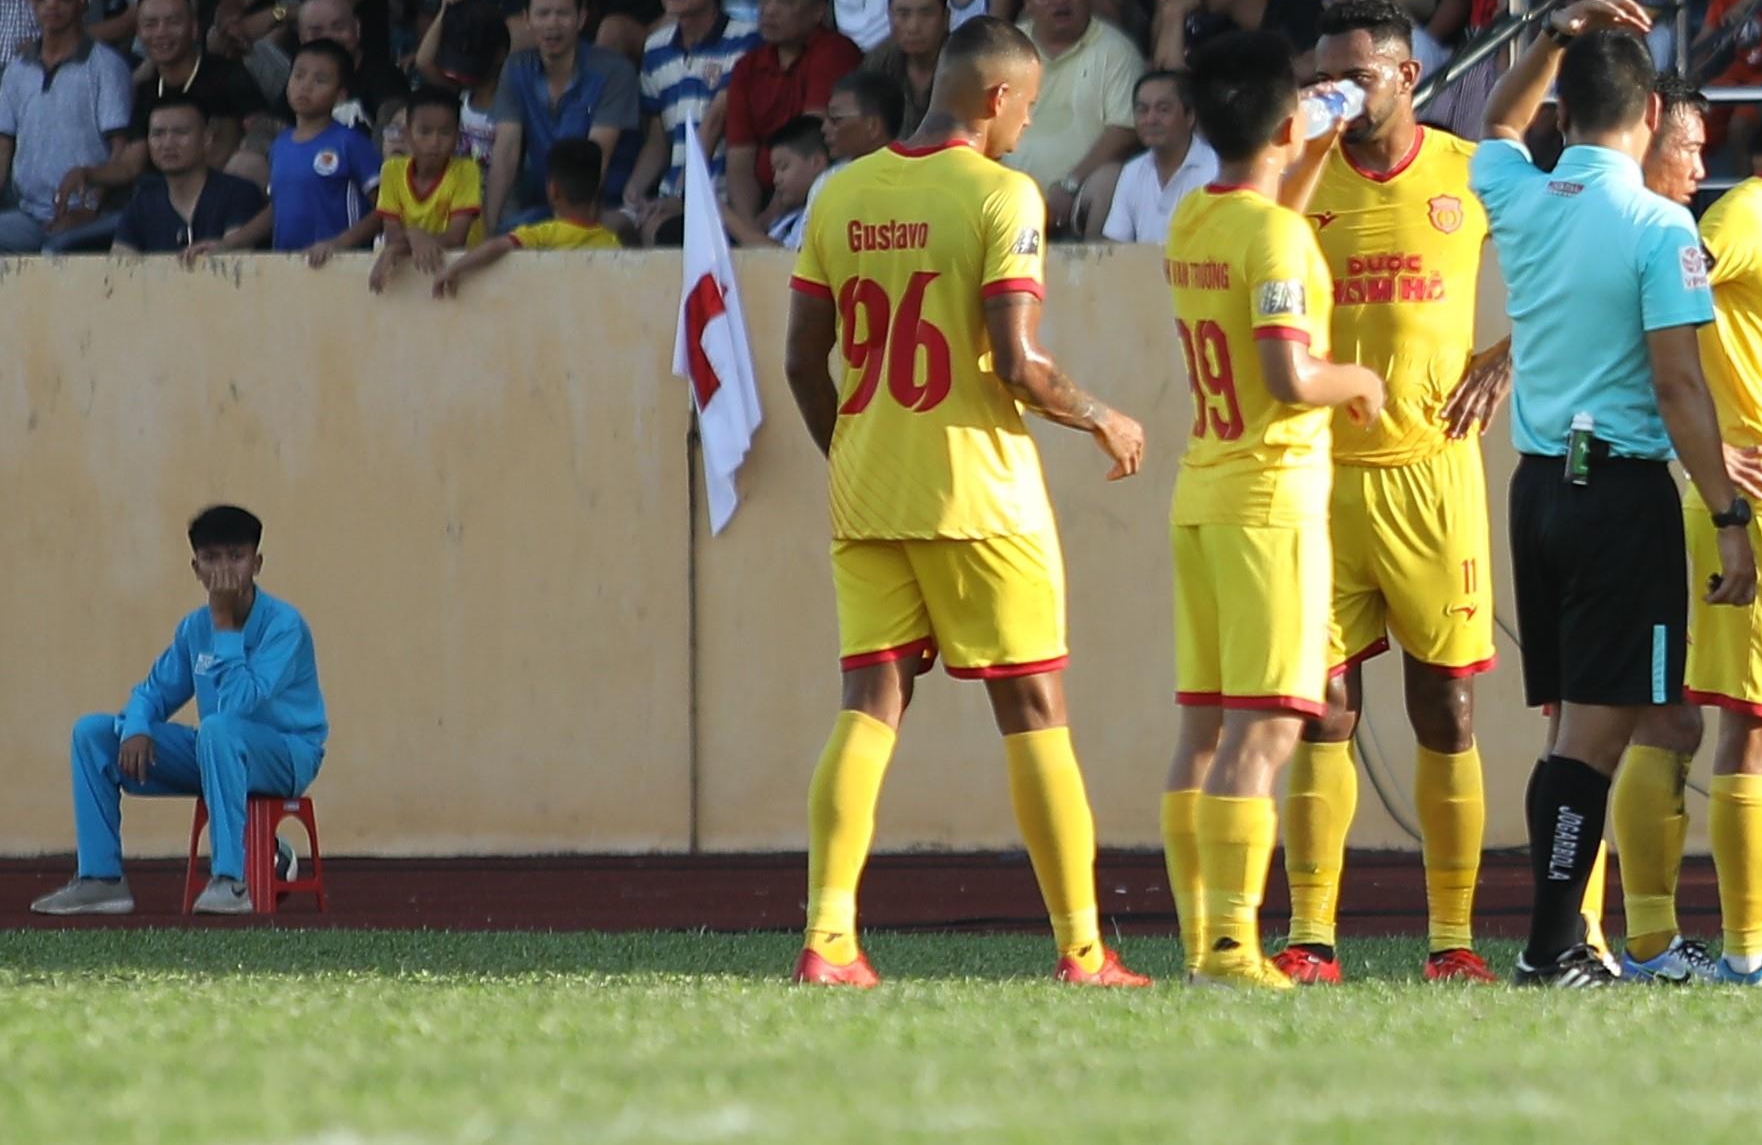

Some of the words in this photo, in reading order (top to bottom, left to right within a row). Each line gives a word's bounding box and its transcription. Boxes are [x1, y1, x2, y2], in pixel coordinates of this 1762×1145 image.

[847, 219, 929, 253] Gustavo
[838, 270, 952, 416] 96
[1461, 557, 1476, 595] 11
[1547, 805, 1584, 881] JOGARBOLA
